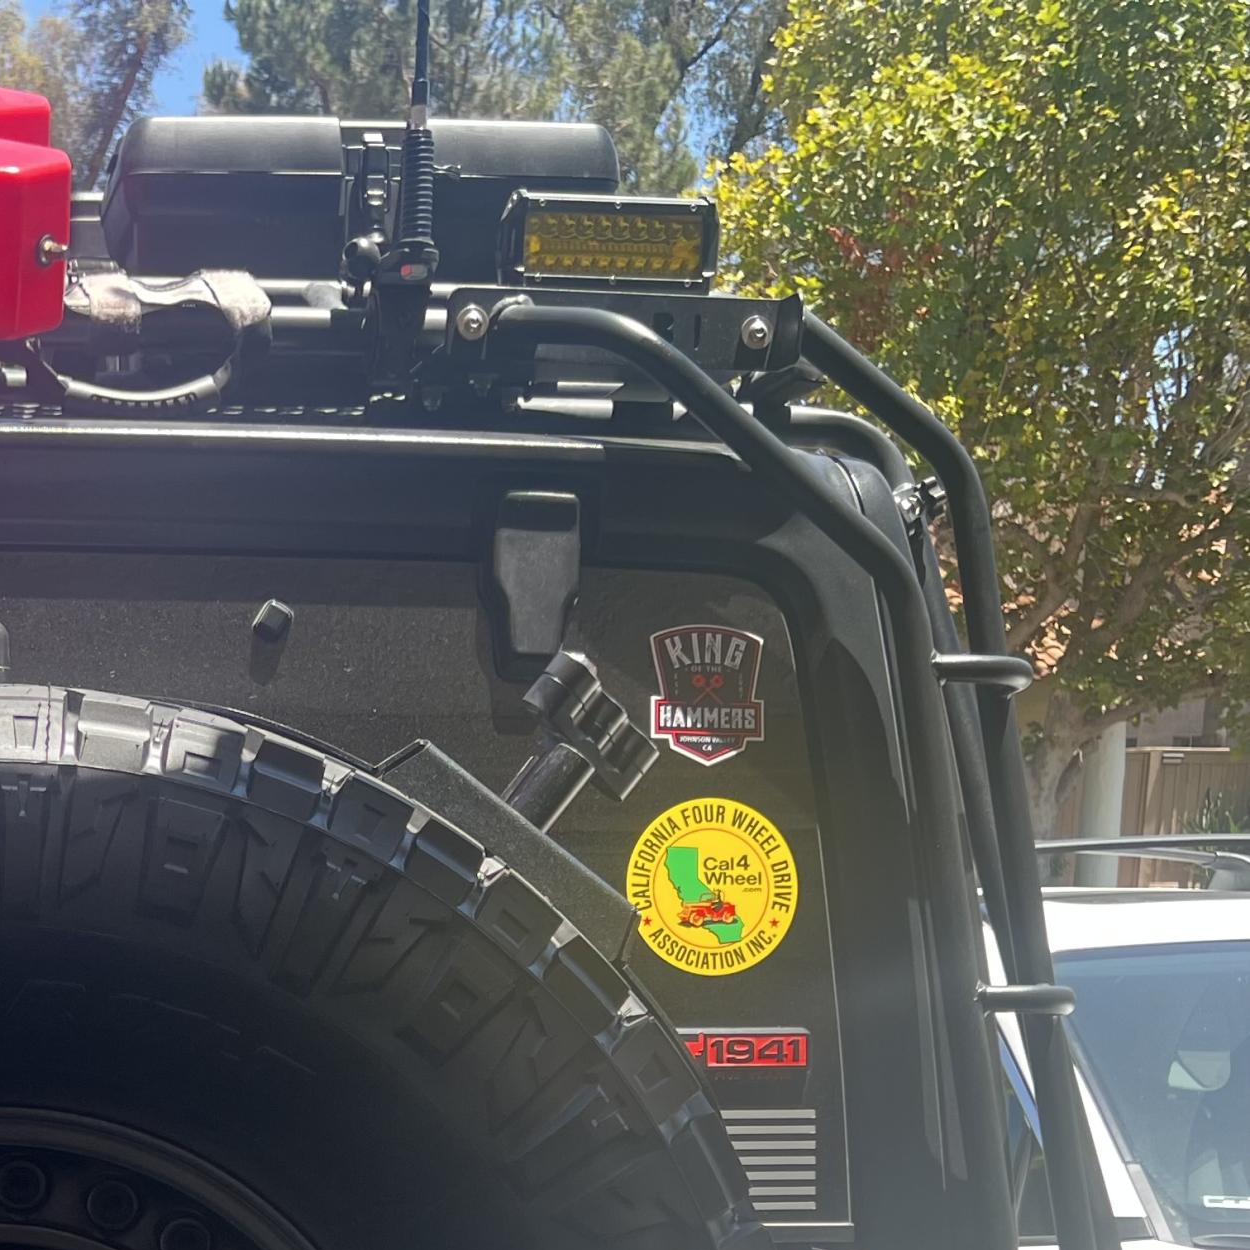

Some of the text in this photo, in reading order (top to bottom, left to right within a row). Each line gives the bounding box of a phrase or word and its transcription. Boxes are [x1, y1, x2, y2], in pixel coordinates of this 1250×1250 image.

[664, 632, 748, 670] KING
[659, 704, 756, 730] HAMMERS
[679, 735, 711, 743] JOHNSON
[701, 744, 713, 752] CA
[632, 804, 792, 914] CALIFORNIA FOUR WHEEL DRIVE
[704, 871, 762, 886] Wheel
[648, 927, 777, 970] ASSOCIATION INC.
[710, 1038, 800, 1065] 1941
